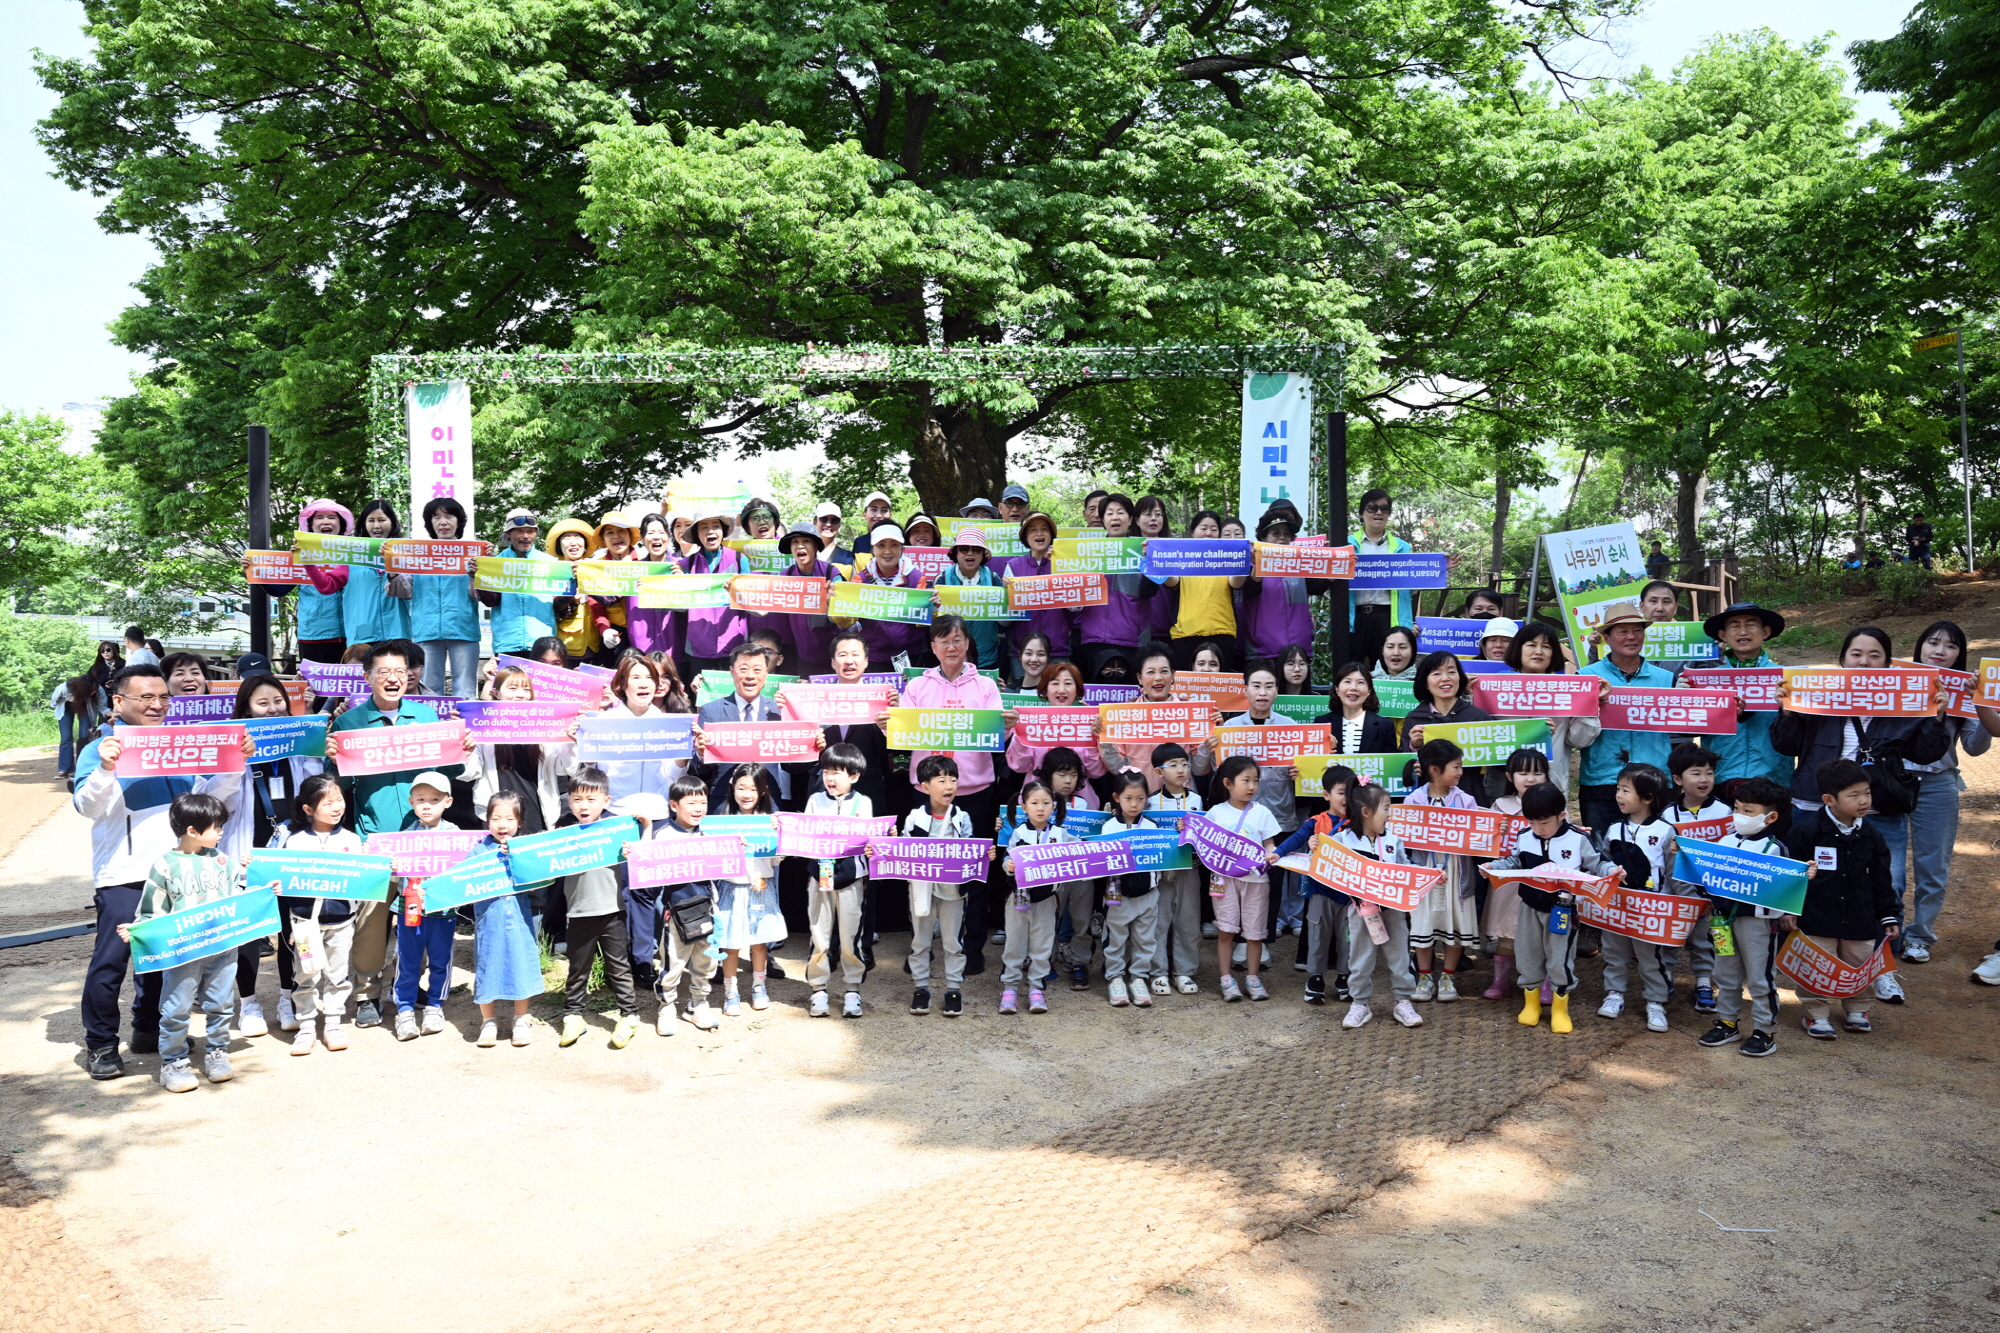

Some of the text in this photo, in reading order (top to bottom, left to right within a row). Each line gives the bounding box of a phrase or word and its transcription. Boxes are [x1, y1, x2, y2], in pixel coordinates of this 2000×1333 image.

[321, 537, 370, 553] 이민청!
[391, 544, 482, 557] 이민청! 안산의 길!
[1076, 541, 1122, 557] 이민청!
[1261, 546, 1333, 559] 이민청! 안산의
[251, 555, 289, 566] 이민청!
[300, 549, 349, 563] 안산시가
[1152, 550, 1247, 560] Ansan's new challenge!
[1564, 541, 1629, 570] 나무심기 순서
[391, 557, 460, 571] 대한민국의
[502, 561, 550, 578] 이민청!
[603, 564, 649, 579] 이민청!
[1055, 557, 1104, 572] 안산시가
[1152, 560, 1246, 569] The Immigration Department!
[1260, 558, 1350, 575] 대한민국의 길!
[1390, 559, 1441, 569] The Immigration
[1391, 569, 1408, 578] new
[1410, 569, 1441, 578] Ansan's
[479, 576, 571, 593] 안산시가 합니다!
[583, 579, 630, 592] 안산시가
[772, 580, 804, 593] 안산의
[806, 582, 821, 594] 길!
[1013, 574, 1101, 592] 이민청! 안산의 길!
[735, 592, 821, 609] 대한민국의 길!
[859, 587, 908, 605] 이민청!
[959, 588, 1005, 603] 이민청!
[1014, 587, 1102, 606] 대한민국의 길!
[834, 600, 929, 621] 안산시가 합니다!
[938, 604, 985, 618] 안산시가
[1421, 628, 1454, 638] Ansan's
[1454, 629, 1473, 638] new
[1421, 637, 1474, 648] The Immigration
[1668, 643, 1713, 658] 합니다!
[563, 685, 590, 697] Ansan!
[1187, 684, 1228, 693] Intercultural
[1228, 686, 1242, 695] City
[1479, 680, 1593, 692] 이민청은 상호문화도시
[1791, 674, 1929, 691] 이민청! 안산의 길!
[827, 690, 887, 702] 상호문화도시
[1497, 693, 1573, 710] 안산으로
[1608, 694, 1730, 709] 이민청은 상호문화도시
[1790, 691, 1929, 712] 대한민국의 길!
[500, 706, 528, 718] phòng
[802, 702, 870, 719] 안산으로
[1106, 707, 1209, 722] 이민청! 안산의 길!
[1627, 708, 1708, 727] 안산으로
[472, 718, 490, 727] Con
[519, 717, 535, 727] của
[536, 718, 565, 727] Ansan!
[918, 711, 974, 730] 이민청!
[286, 730, 306, 739] город
[528, 728, 546, 738] Hàn
[582, 730, 690, 742] Ansan's new challenge!
[704, 730, 762, 747] 이민청은
[1025, 724, 1093, 742] 안산으로
[1106, 721, 1210, 739] 대한민국의 길!
[1220, 729, 1324, 744] 이민청! 안산의 길!
[1456, 724, 1516, 744] 이민청!
[124, 733, 239, 748] 이민청은 상호문화도시
[342, 728, 460, 750] 이민청은 상호문화도시
[892, 731, 1000, 748] 안산시가 합니다!
[250, 740, 295, 758] нсан!
[363, 742, 442, 768] 안산으로
[583, 741, 689, 755] The Immigration Department!
[758, 739, 809, 757] 안산으로
[141, 747, 219, 770] 안산으로
[1428, 811, 1495, 832] 안산의 길!
[876, 841, 986, 859] 安山的新挑战!
[1153, 842, 1171, 851] город
[1468, 831, 1494, 852] 길!
[1017, 840, 1125, 863] 安山的新挑战!
[549, 848, 605, 873] Ансан!
[877, 859, 983, 878] 和移民厅一起!
[1023, 854, 1130, 883] 和移民厅一起!
[1320, 842, 1411, 887] 이민청! 안산의
[1713, 852, 1806, 878] миграционной службы!
[637, 857, 741, 883] 和移民厅一起!
[1694, 857, 1773, 883] Этим займётся город
[287, 875, 349, 893] Ансан!
[1315, 857, 1403, 905] 대한민국의
[1701, 871, 1759, 897] Ансан!
[1626, 895, 1699, 921] 안산의 길!
[174, 902, 237, 934] Ансан!
[1577, 900, 1665, 937] 대한민국의
[1791, 936, 1837, 975] 이민청!
[1782, 950, 1870, 994] 대한민국의
